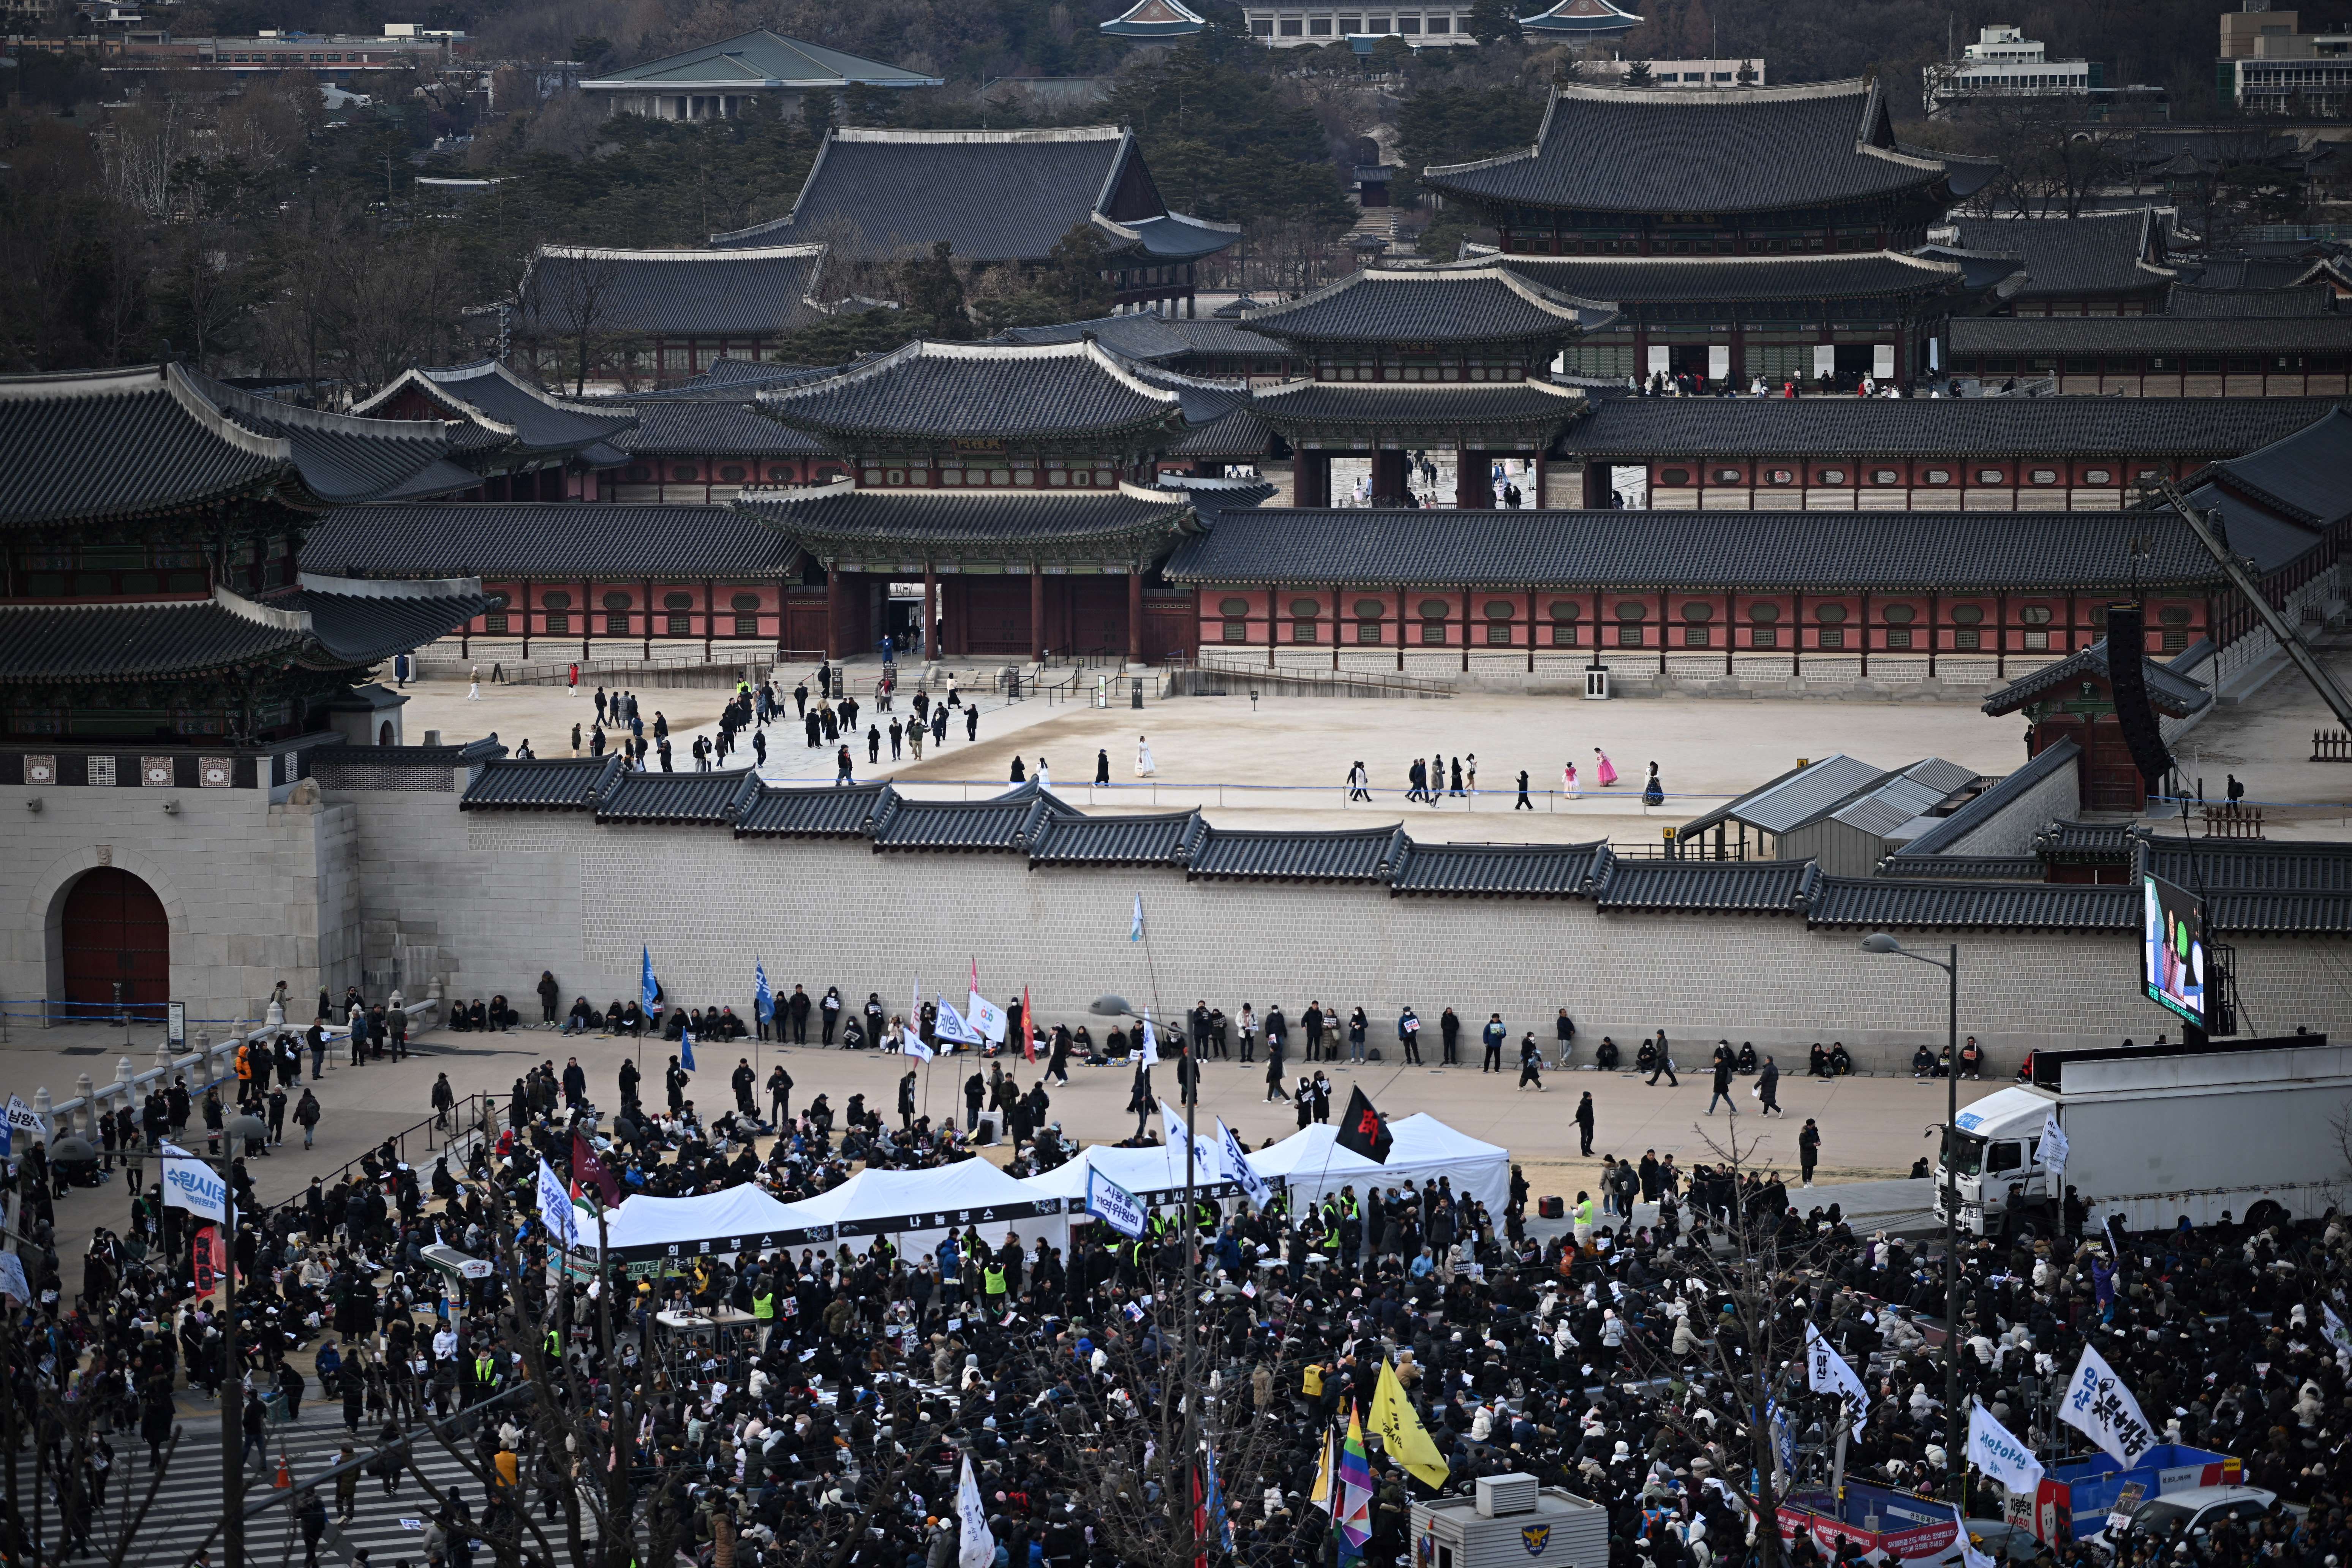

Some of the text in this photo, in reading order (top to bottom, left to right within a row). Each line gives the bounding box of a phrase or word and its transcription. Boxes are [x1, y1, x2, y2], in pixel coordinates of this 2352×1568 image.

[185, 1193, 217, 1209] 지역위원회
[1096, 1195, 1138, 1226] 지역위원회
[2011, 1497, 2031, 1516] 차량주변
[1887, 1538, 1908, 1548] SK텔레콤
[1932, 1530, 1956, 1540] 장비입니다.
[1900, 1545, 1914, 1554] 안전에
